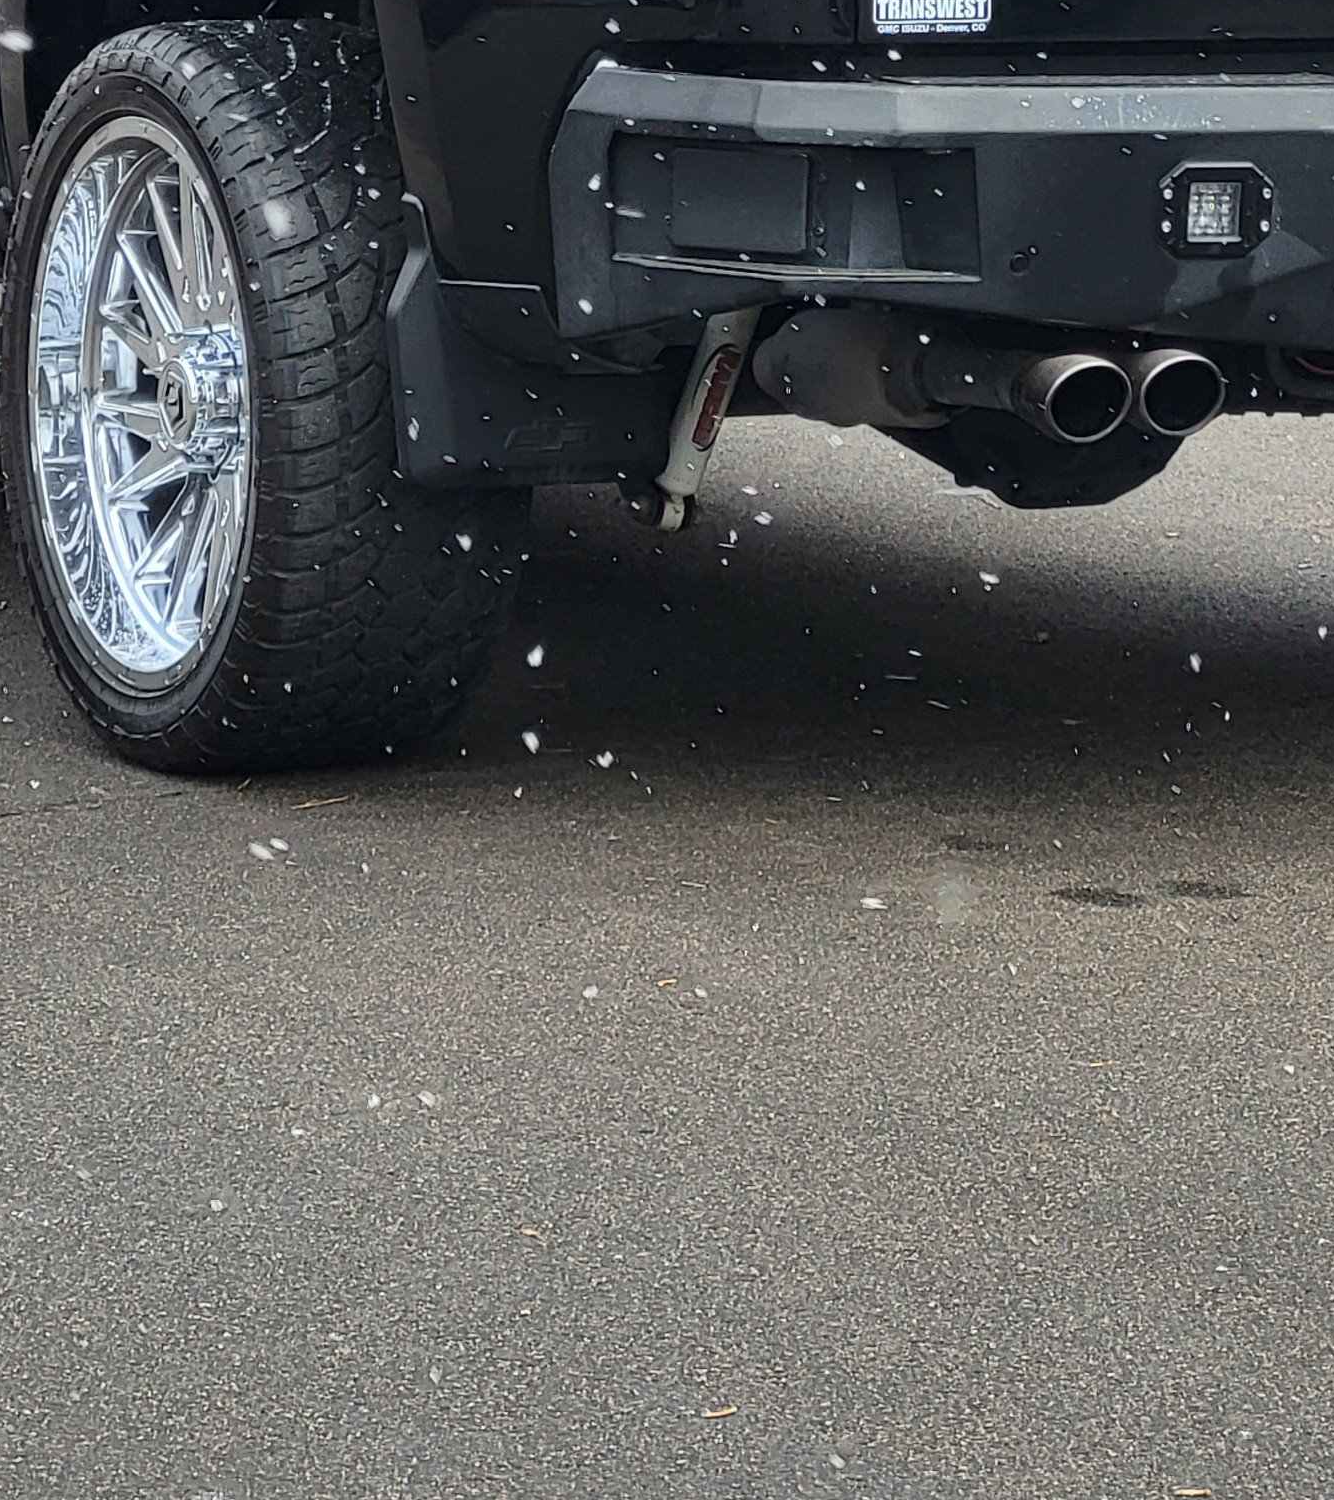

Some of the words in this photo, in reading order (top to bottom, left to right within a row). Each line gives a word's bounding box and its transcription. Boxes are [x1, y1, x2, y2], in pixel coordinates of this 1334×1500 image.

[877, 25, 900, 34] GMC
[901, 24, 930, 33] ISUZU
[971, 23, 987, 32] CO
